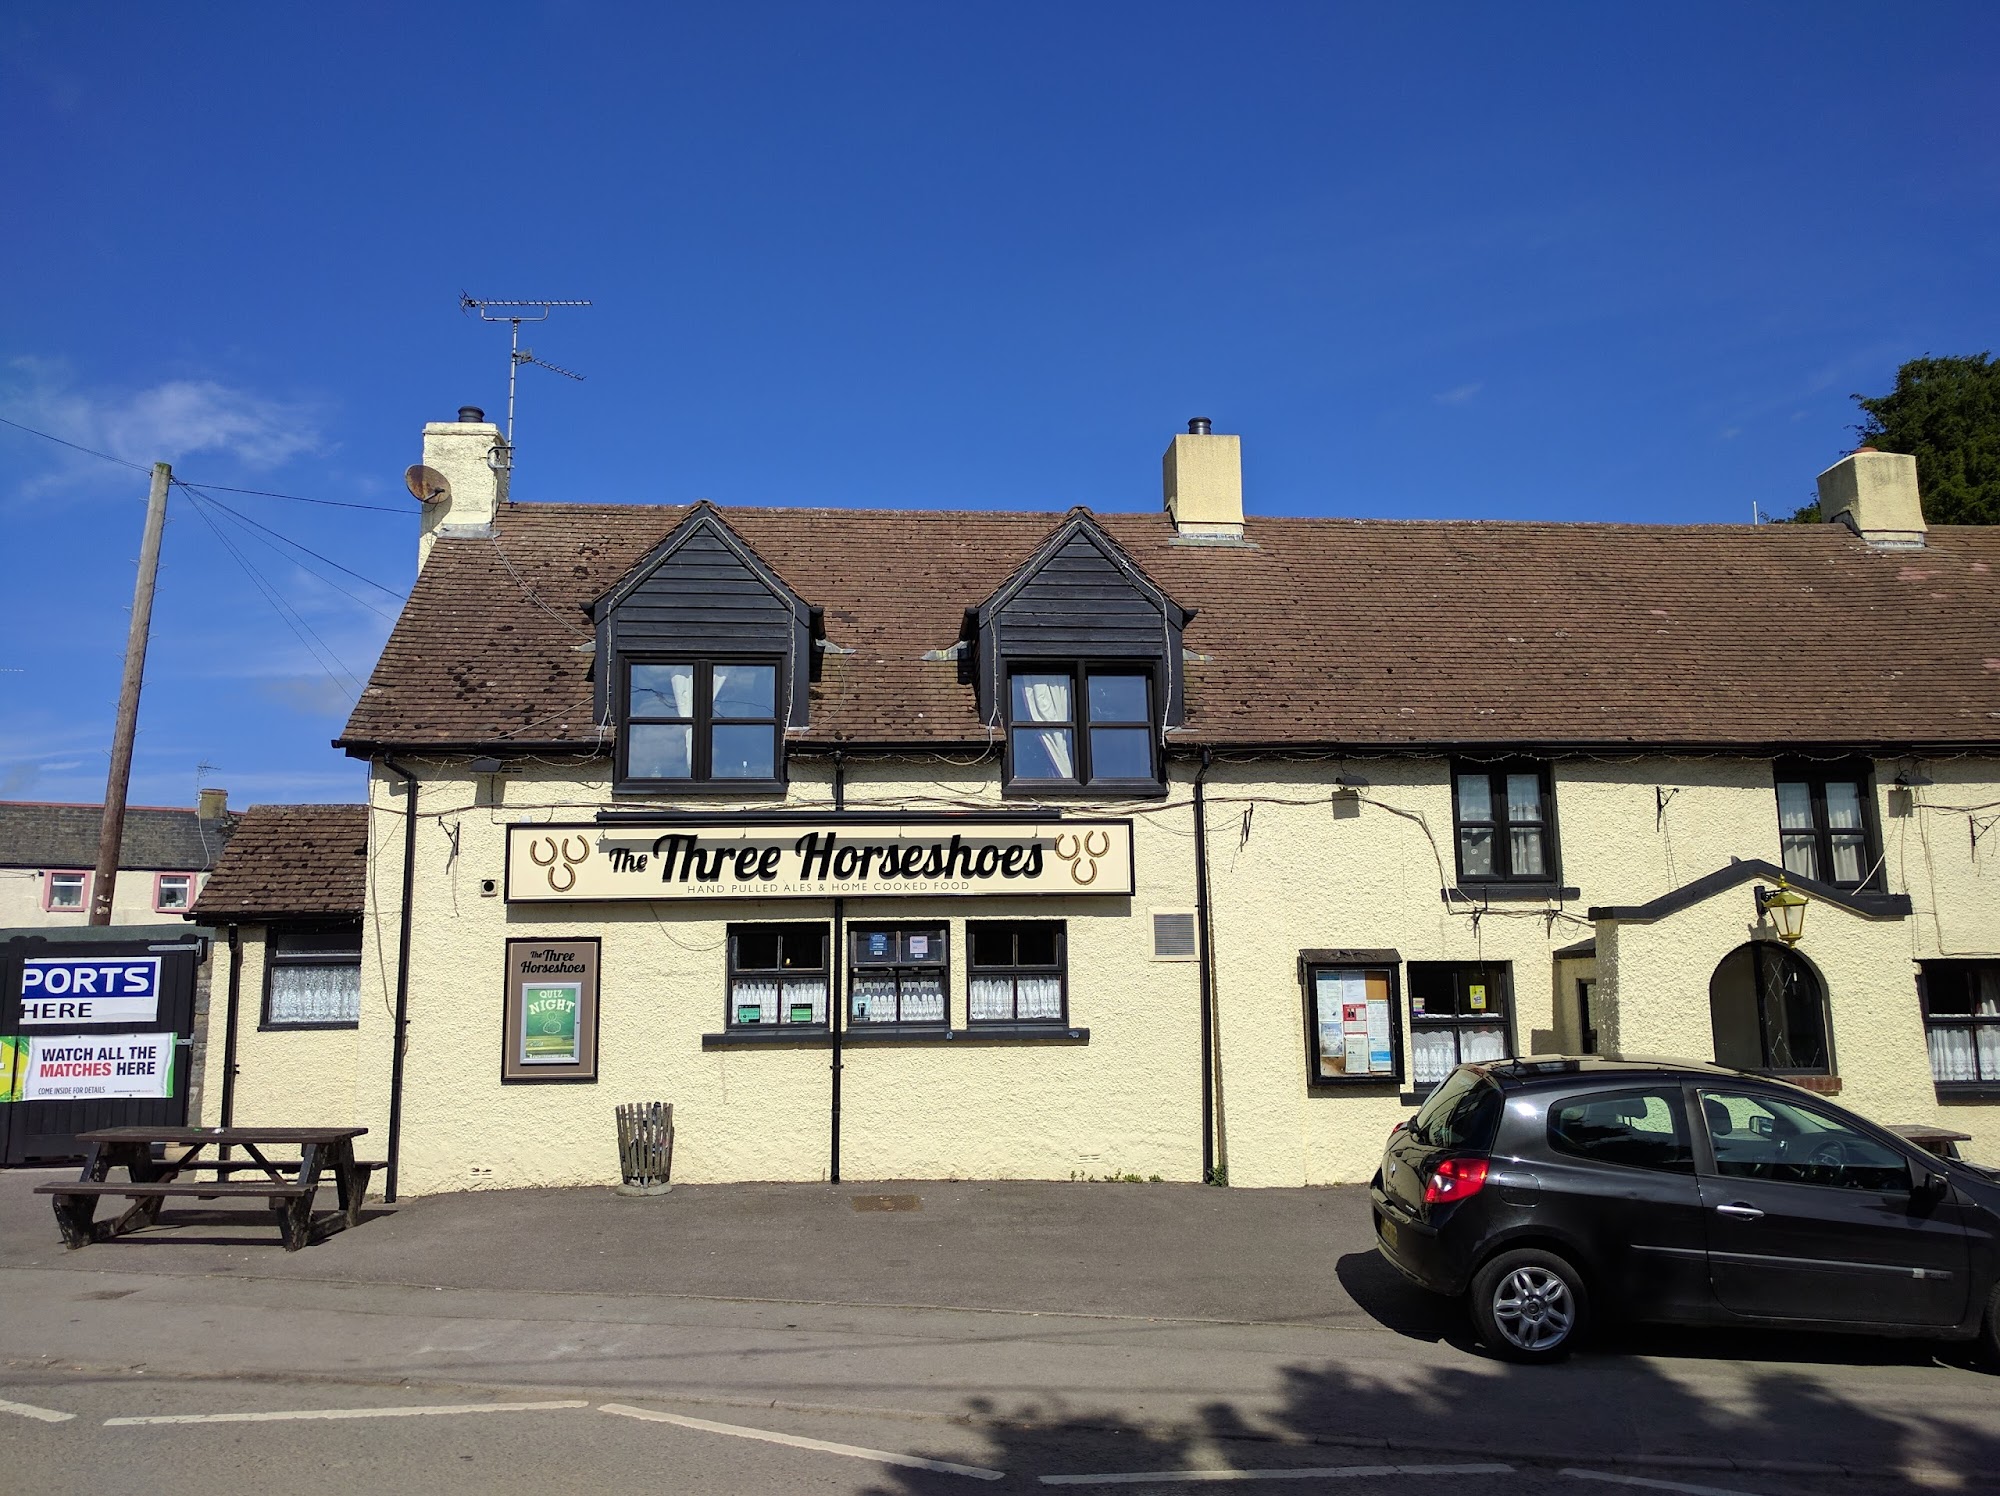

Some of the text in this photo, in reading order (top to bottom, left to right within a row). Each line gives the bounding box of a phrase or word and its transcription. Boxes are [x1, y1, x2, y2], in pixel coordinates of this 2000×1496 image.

[609, 831, 1044, 882] The Three Horseshoes
[687, 881, 969, 894] HAND PULLED ALES & HOME COOKED FOOD
[543, 949, 575, 962] Three
[520, 961, 586, 974] Horseshoes
[21, 967, 149, 994] PORTS
[539, 989, 563, 999] QUIZ
[20, 1003, 93, 1019] HERE
[528, 999, 575, 1015] NIGHT
[42, 1046, 156, 1061] WATCH ALL THE
[40, 1062, 156, 1077] MATCHES HERE
[38, 1087, 53, 1095] COME
[54, 1087, 72, 1095] INSIDE
[73, 1086, 83, 1094] FOR
[85, 1086, 105, 1094] DETAILS
